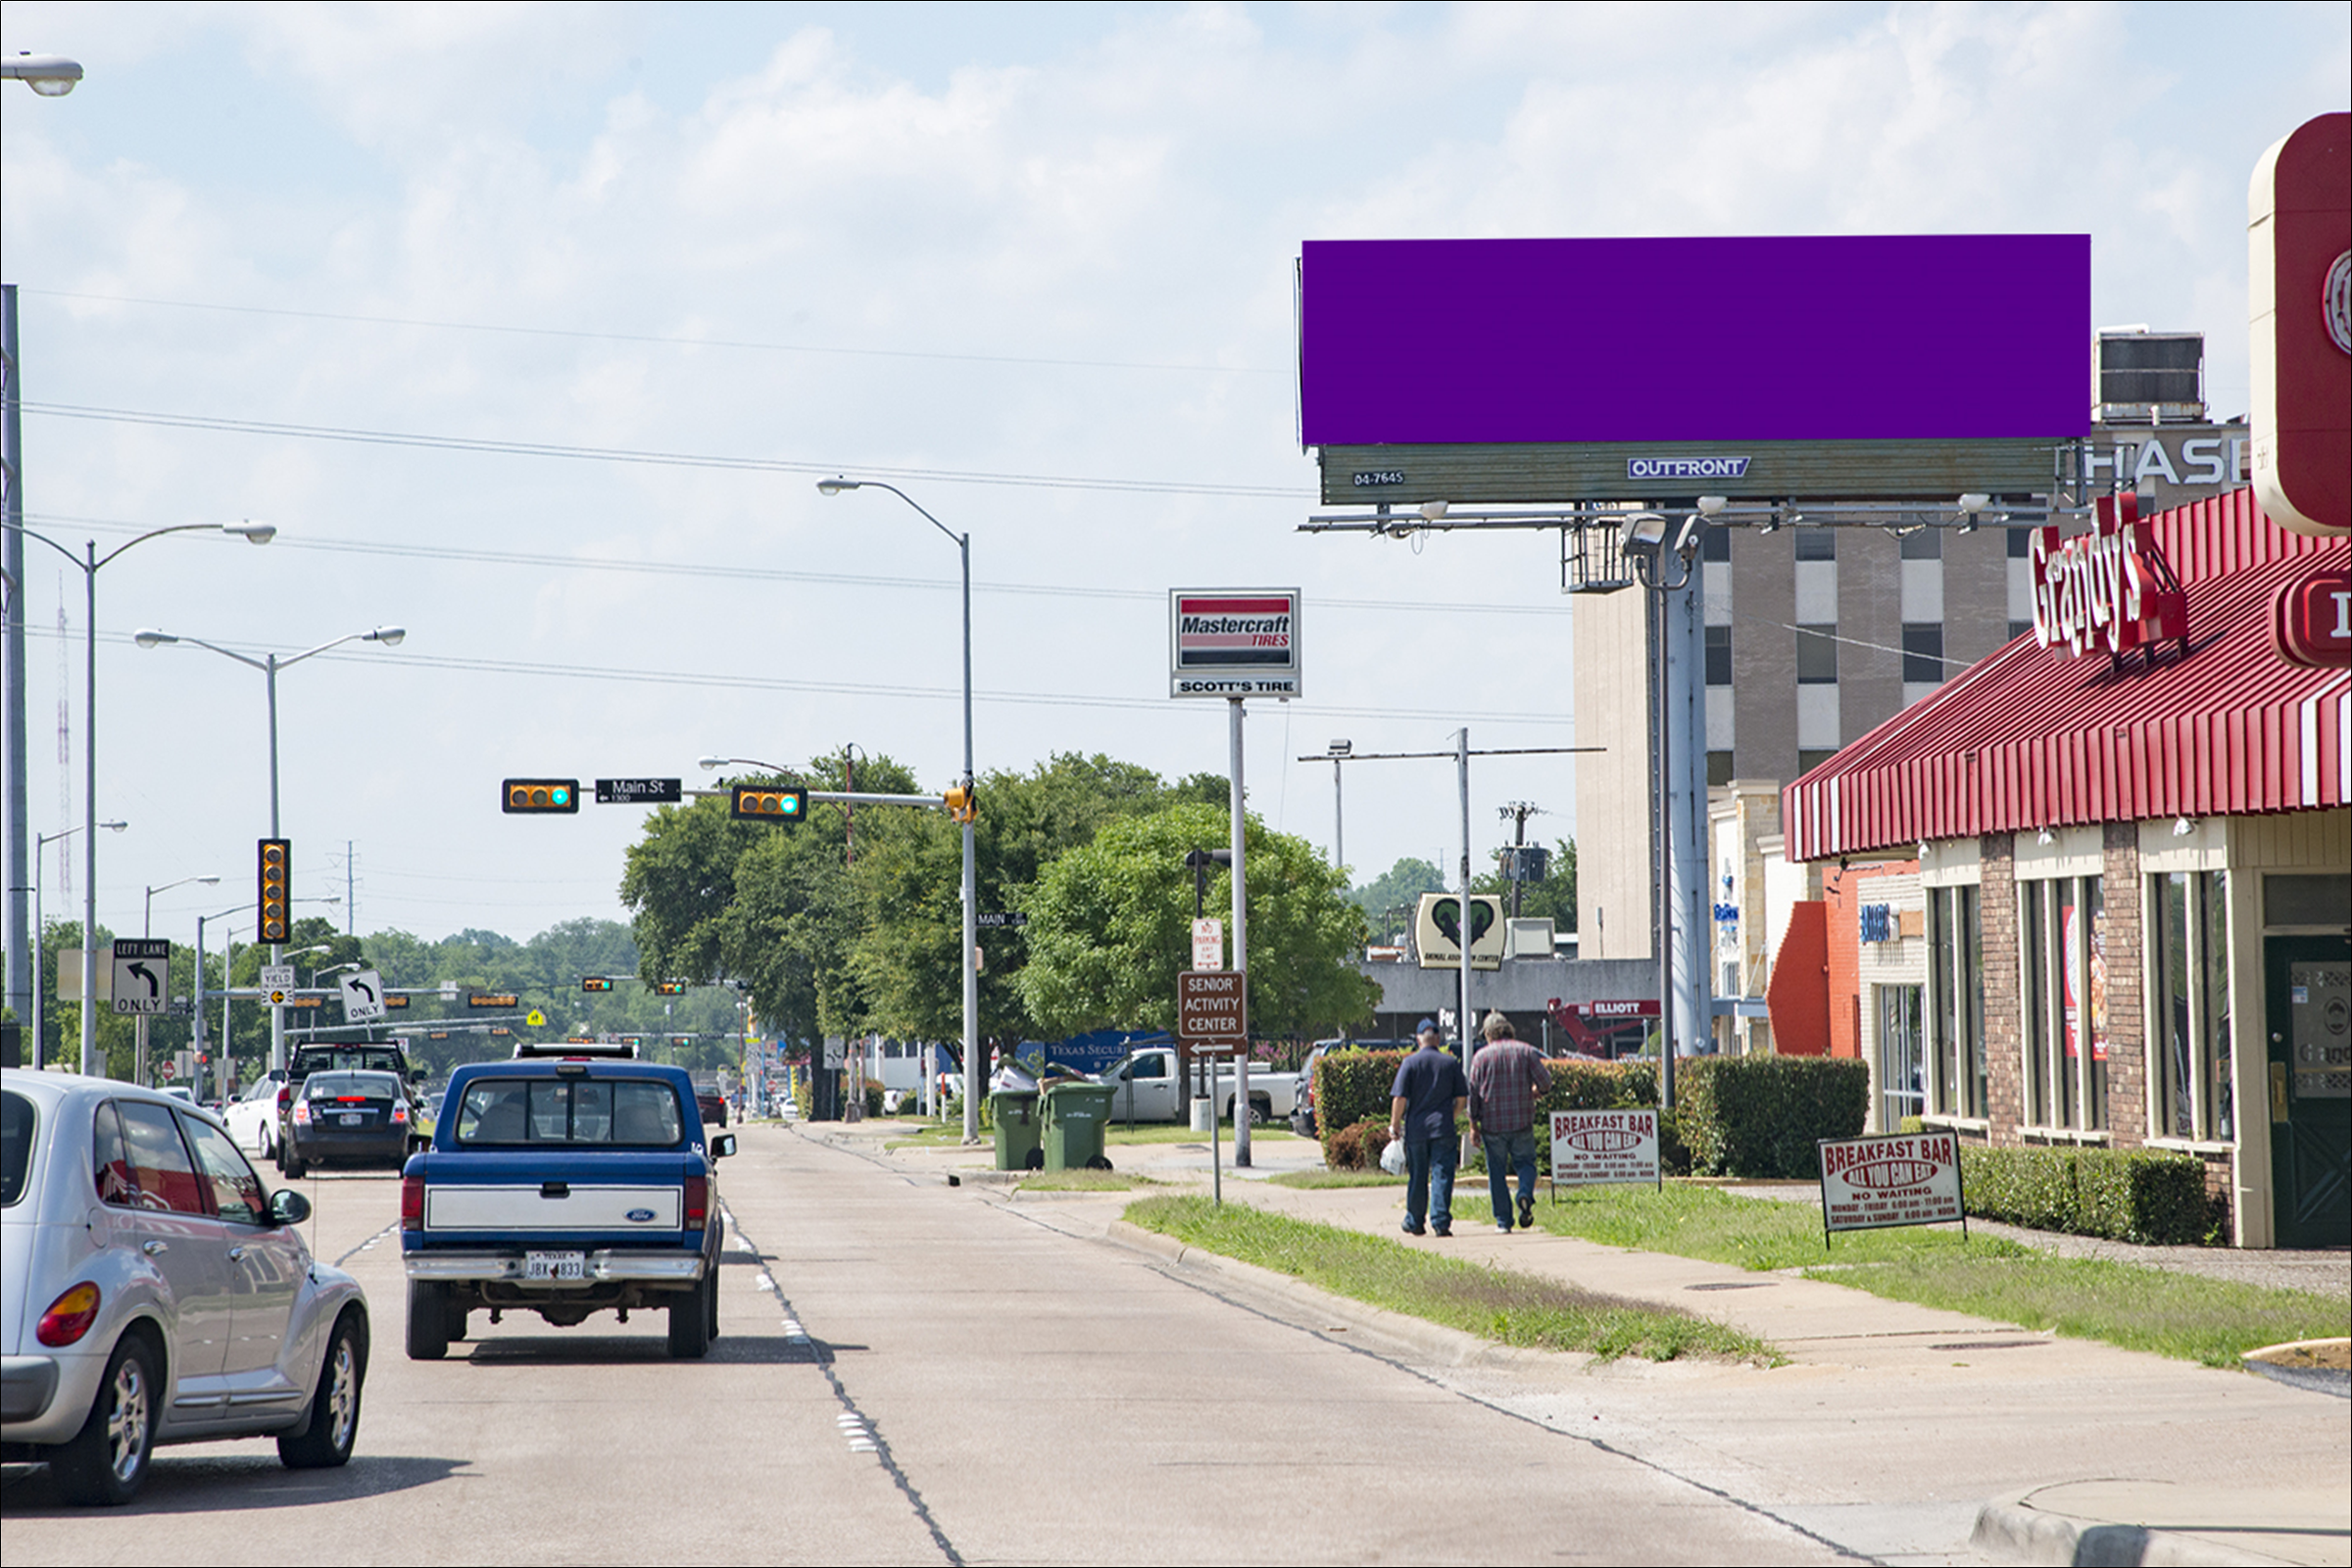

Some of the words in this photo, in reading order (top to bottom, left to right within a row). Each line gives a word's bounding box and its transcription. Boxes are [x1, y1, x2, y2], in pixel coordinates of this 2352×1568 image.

[1632, 460, 1743, 475] OUTFRONT
[2066, 438, 2251, 485] HAS
[1354, 471, 1403, 486] 04-7645
[2028, 490, 2142, 658] Grandy's
[1181, 616, 1290, 634] Mastercraft
[1251, 634, 1290, 647] TIRES
[1180, 681, 1252, 692] SCOTT'S
[1255, 681, 1294, 692] TIRE
[612, 780, 647, 793] Main
[649, 780, 665, 794] St
[978, 913, 1005, 925] MAIN
[1200, 924, 1213, 934] NO
[1195, 935, 1220, 945] PARKING
[118, 943, 138, 956] LEFT
[143, 943, 167, 956] LANE
[265, 974, 291, 983] YIELD
[1188, 977, 1234, 992] SENIOR
[119, 999, 161, 1011] ONLY
[350, 1004, 379, 1018] ONLY
[1184, 998, 1240, 1011] ACTIVITY
[1594, 1004, 1640, 1013] ELLIOTT
[1188, 1017, 1237, 1031] CENTER
[1051, 1045, 1086, 1055] TEXAS
[1087, 1044, 1141, 1055] SECURI
[1554, 1115, 1624, 1142] BREAKFAST
[1628, 1115, 1653, 1139] BAR
[1571, 1133, 1586, 1149] ALL
[1586, 1133, 1602, 1151] YOU
[1604, 1132, 1621, 1151] CAN
[1623, 1134, 1636, 1148] EAT
[1593, 1152, 1637, 1160] WAITING
[1825, 1140, 1914, 1176] BREAKFAST
[1921, 1137, 1953, 1167] BAR
[1847, 1167, 1867, 1185] ALL
[1867, 1163, 1889, 1187] YOU
[1890, 1162, 1913, 1186] CAN
[1914, 1162, 1932, 1181] EAT
[1852, 1192, 1871, 1200] NO
[1877, 1186, 1933, 1200] WAITING
[1831, 1203, 1859, 1212] MONDAY
[1864, 1201, 1887, 1211] FRIDAY
[1925, 1197, 1941, 1206] 11:00
[1831, 1215, 1866, 1224] SATURDAY
[1873, 1212, 1899, 1222] SUNDAY
[1937, 1206, 1956, 1216] NOON
